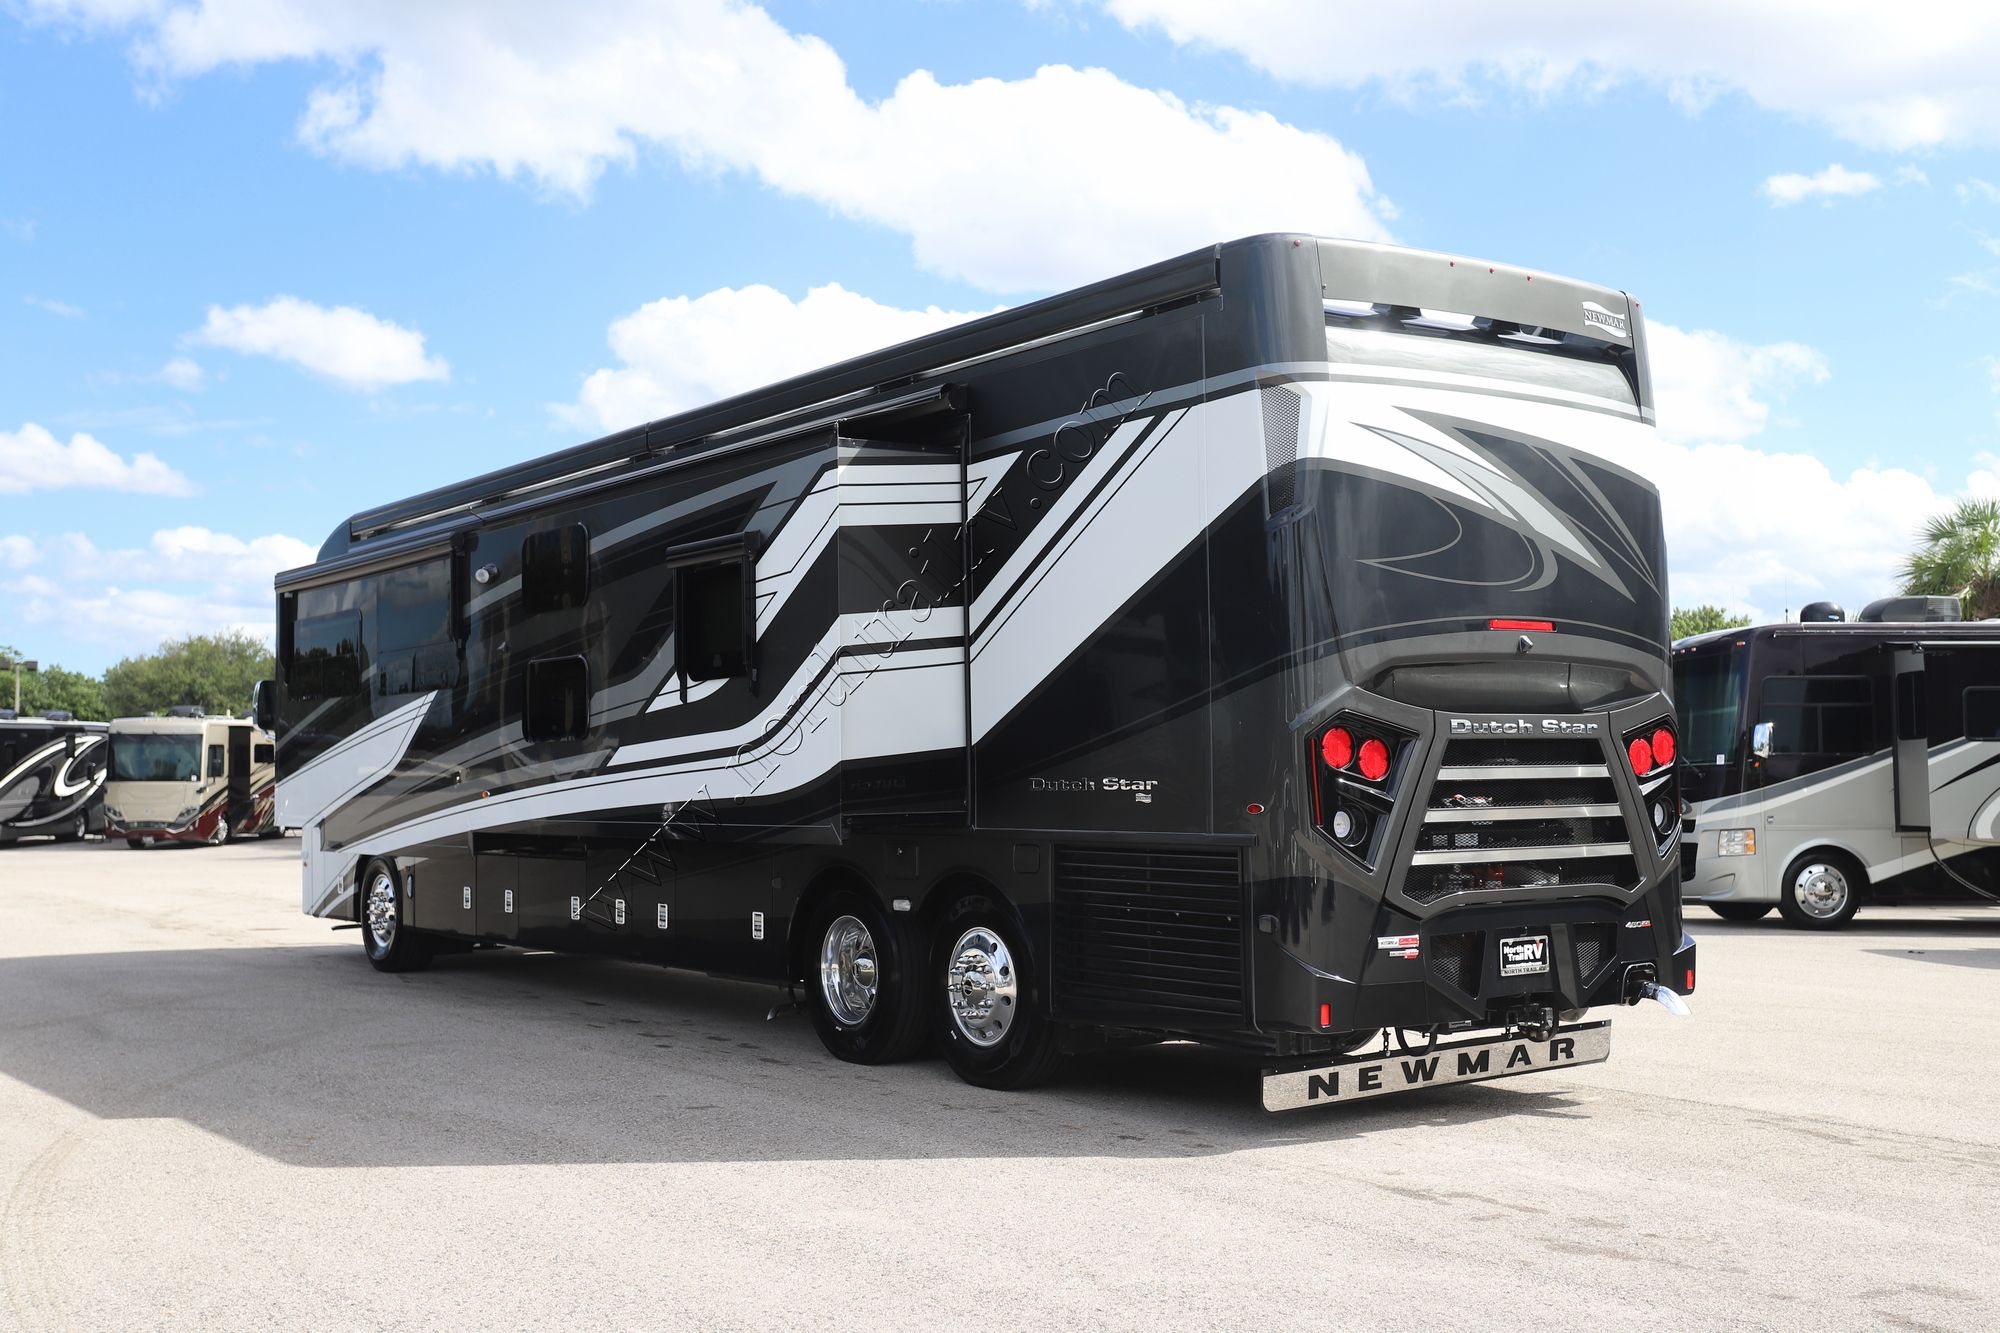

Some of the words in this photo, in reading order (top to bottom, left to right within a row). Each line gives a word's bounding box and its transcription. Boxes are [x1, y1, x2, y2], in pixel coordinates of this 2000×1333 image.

[1583, 309, 1626, 330] NEWMAR
[1449, 718, 1534, 735] Dutch
[1541, 718, 1599, 735] Star
[1029, 776, 1096, 792] Dutch
[1102, 776, 1159, 791] Star
[1503, 945, 1524, 954] North
[1507, 952, 1524, 961] Trail
[1523, 943, 1544, 960] RV
[1308, 1037, 1576, 1100] NEWMAR
